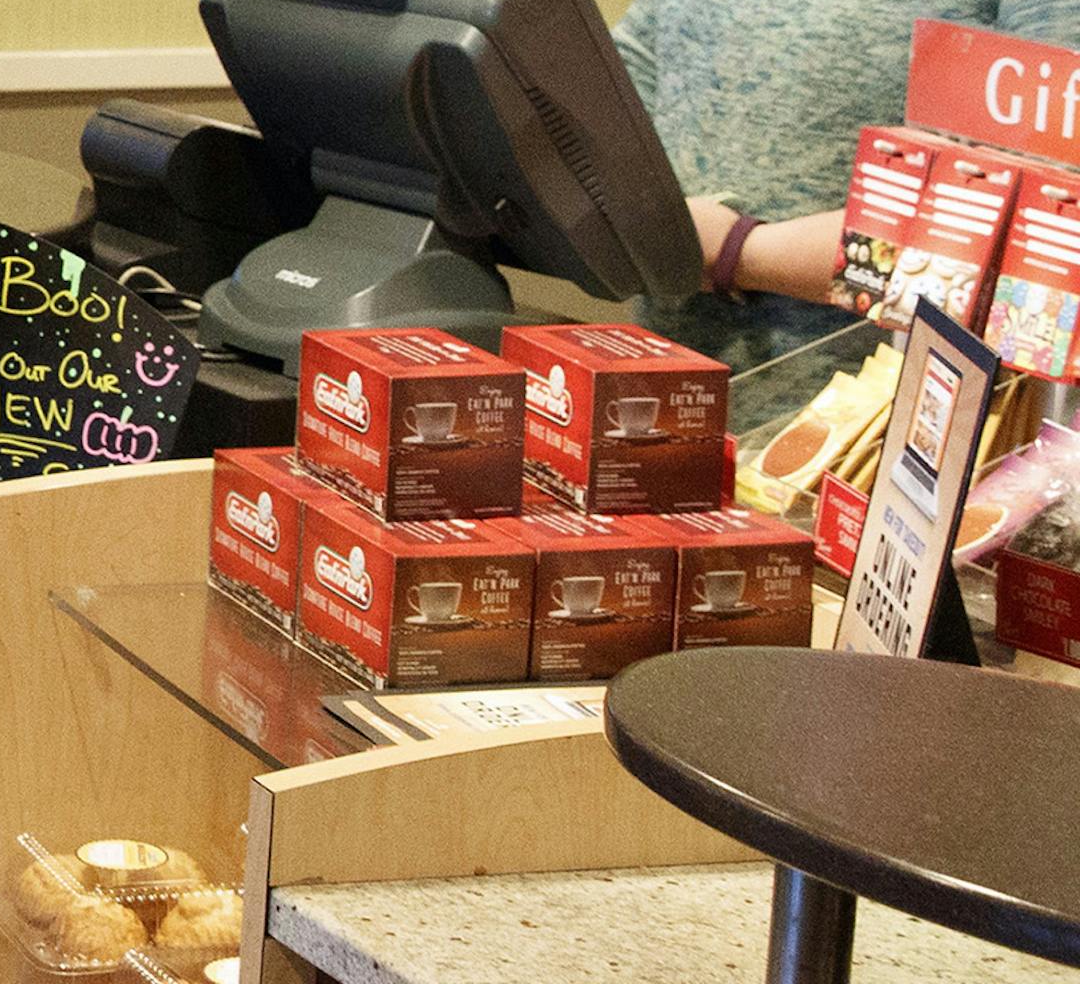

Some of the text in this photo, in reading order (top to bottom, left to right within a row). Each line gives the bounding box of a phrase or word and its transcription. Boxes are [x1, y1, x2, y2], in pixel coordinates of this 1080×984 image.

[476, 411, 505, 424] COFFEE
[678, 406, 706, 420] COFFEE
[873, 533, 917, 611] ONLINE
[481, 591, 510, 605] COFFEE
[856, 572, 912, 657] ORDERING
